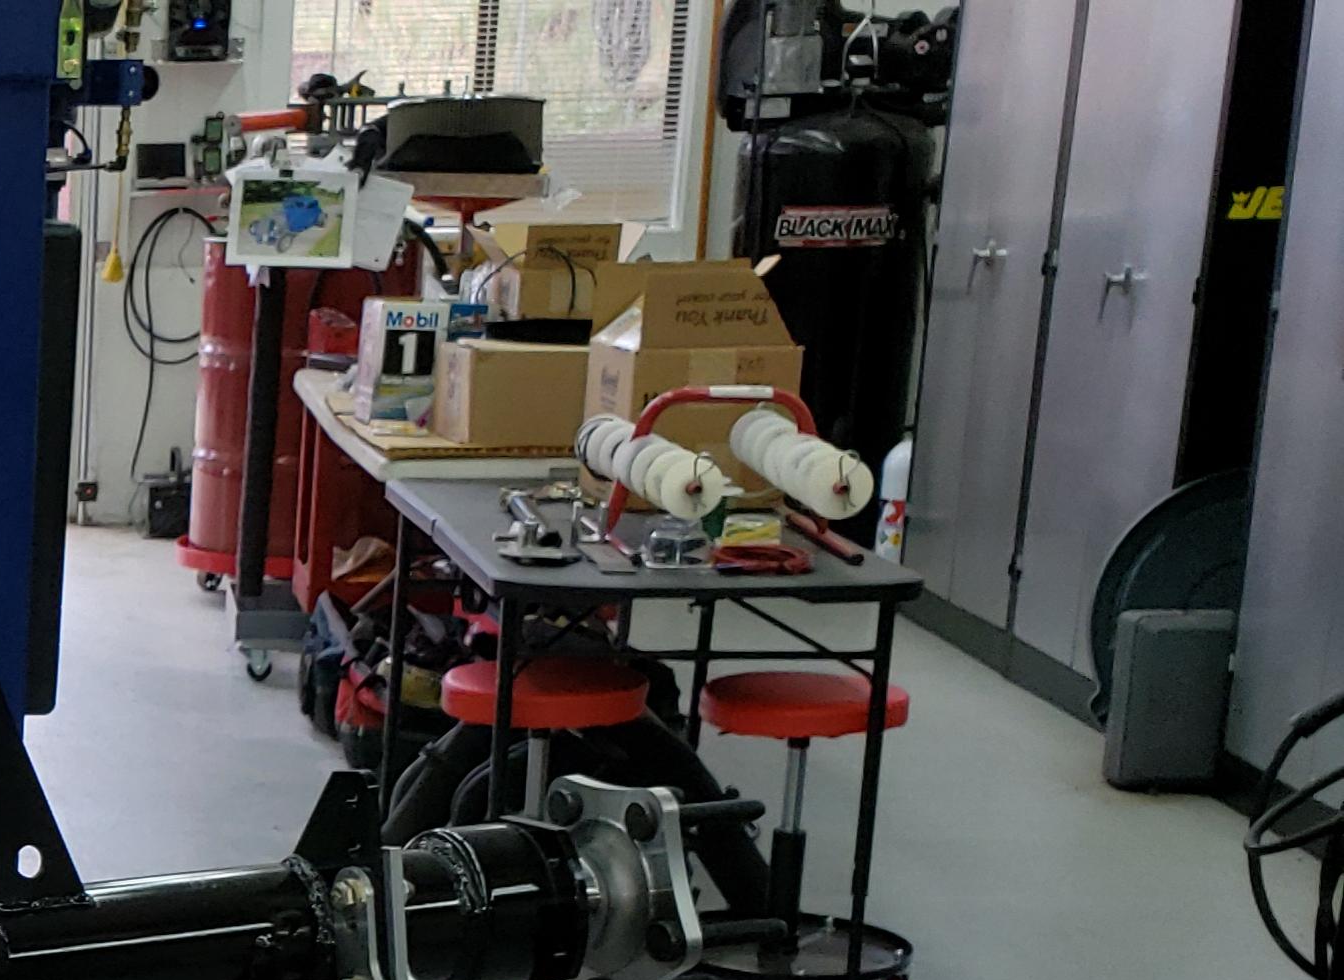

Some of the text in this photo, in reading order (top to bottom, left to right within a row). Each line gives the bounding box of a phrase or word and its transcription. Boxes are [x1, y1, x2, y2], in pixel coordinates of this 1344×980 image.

[777, 214, 896, 239] BLACK MAX
[386, 311, 439, 328] Mobil
[674, 307, 769, 327] Thank You
[398, 331, 418, 375] 1
